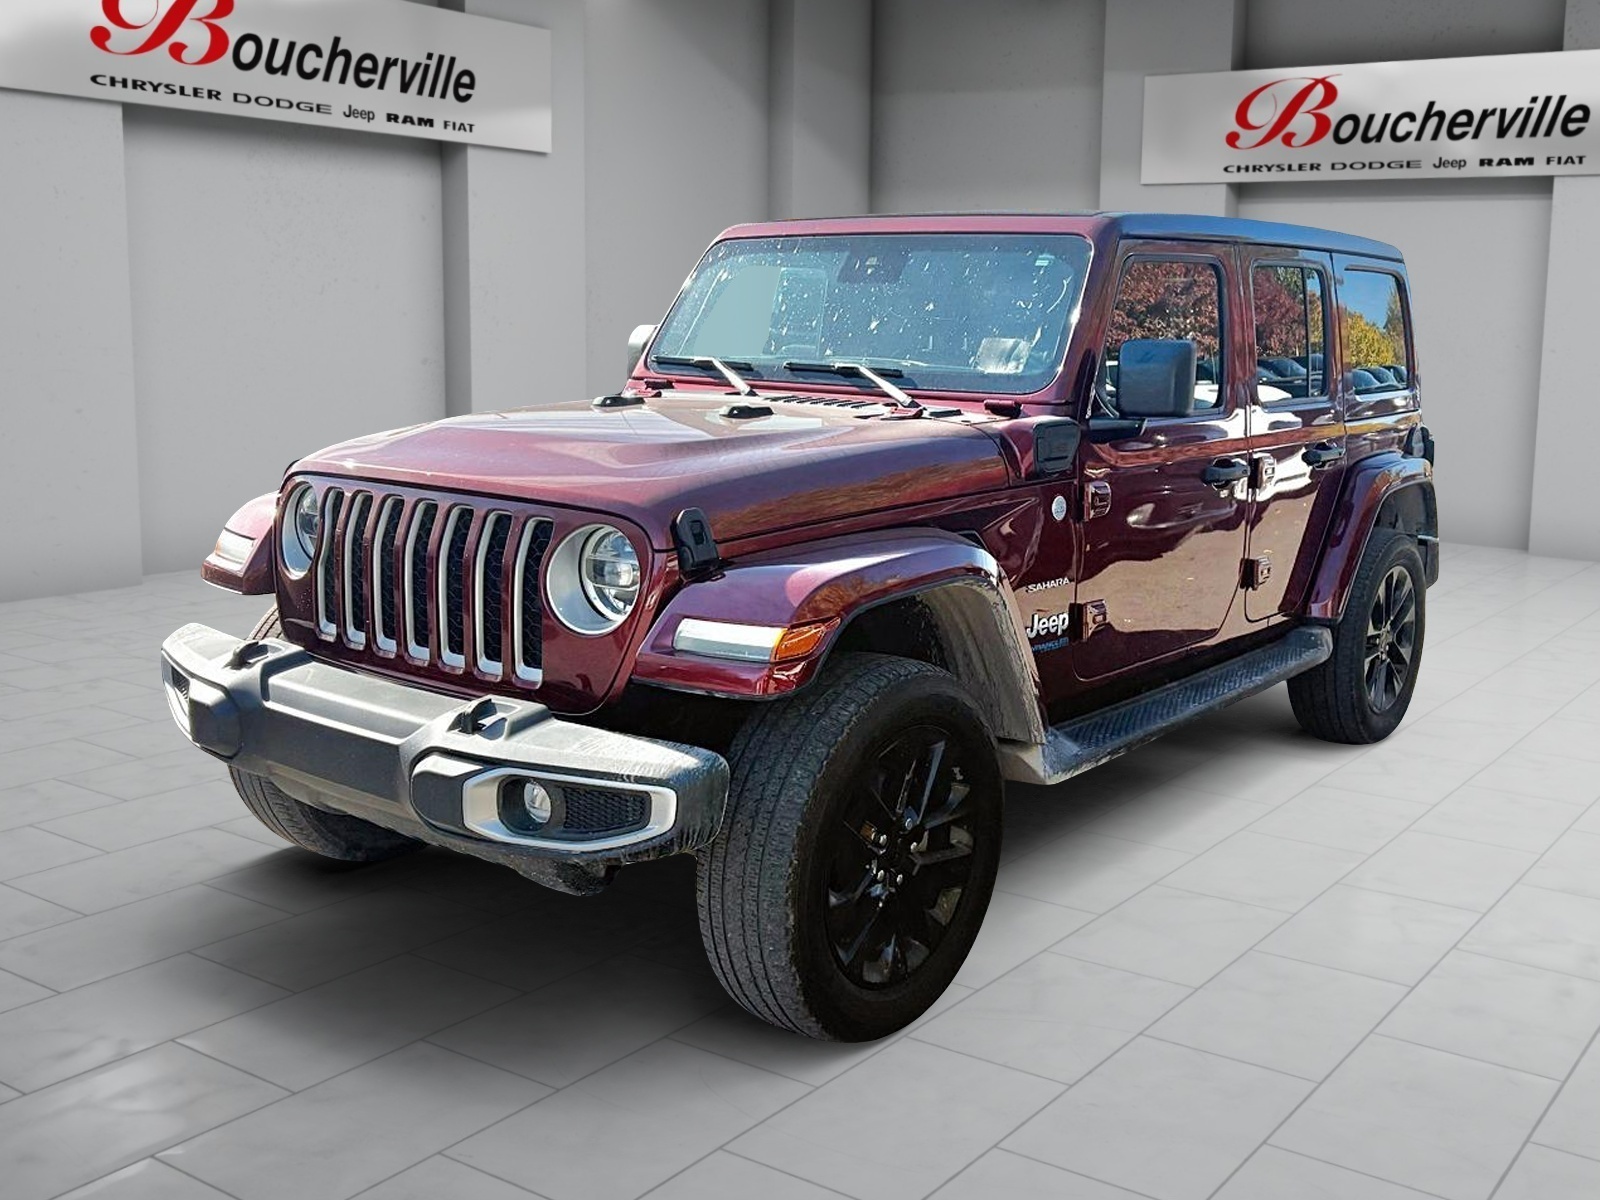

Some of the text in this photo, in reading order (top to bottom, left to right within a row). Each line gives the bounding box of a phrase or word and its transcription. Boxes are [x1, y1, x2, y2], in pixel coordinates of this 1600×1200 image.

[90, 0, 476, 103] Boucherville
[90, 74, 475, 133] CHRYSLER DODGE Jeep RAM FIAT
[1225, 74, 1591, 150] Boucherville
[1223, 155, 1586, 173] CHRYSLER DODGE Jeep RAM FIAT
[1027, 577, 1070, 592] SAHARA
[1026, 612, 1069, 639] Jeep
